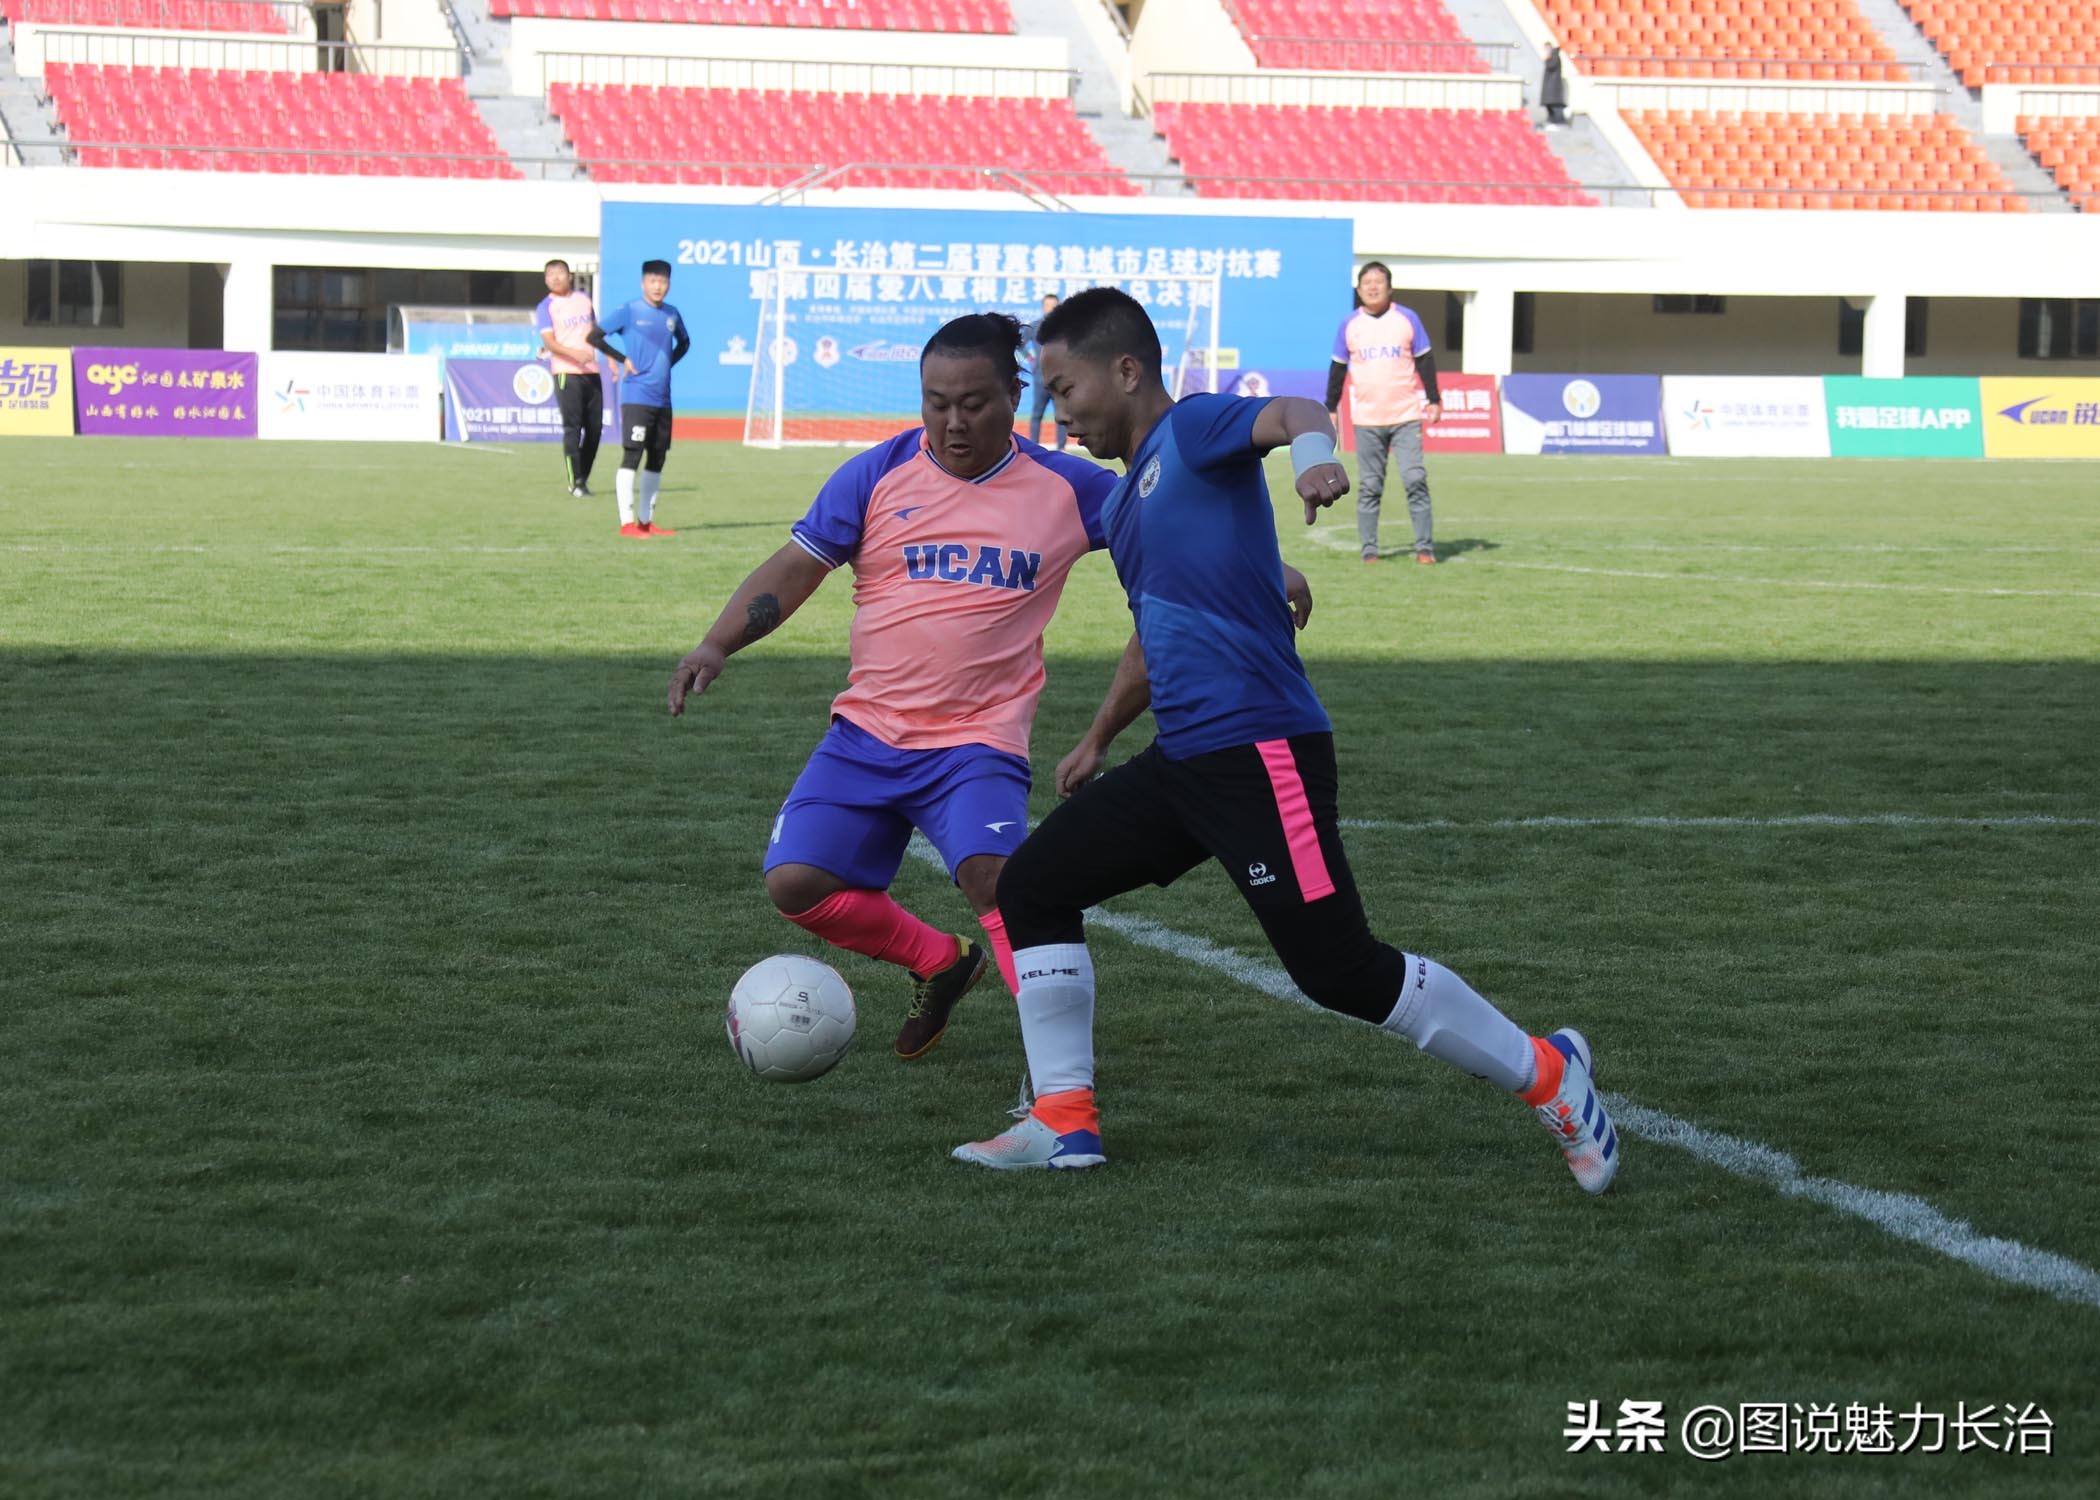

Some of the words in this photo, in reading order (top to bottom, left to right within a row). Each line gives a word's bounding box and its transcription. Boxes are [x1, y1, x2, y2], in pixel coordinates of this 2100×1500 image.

[1358, 346, 1401, 360] UCAN
[903, 544, 1042, 592] UCAN
[1249, 874, 1276, 886] LOOKS
[1021, 968, 1080, 981] KELME
[1416, 956, 1426, 990] KEL
